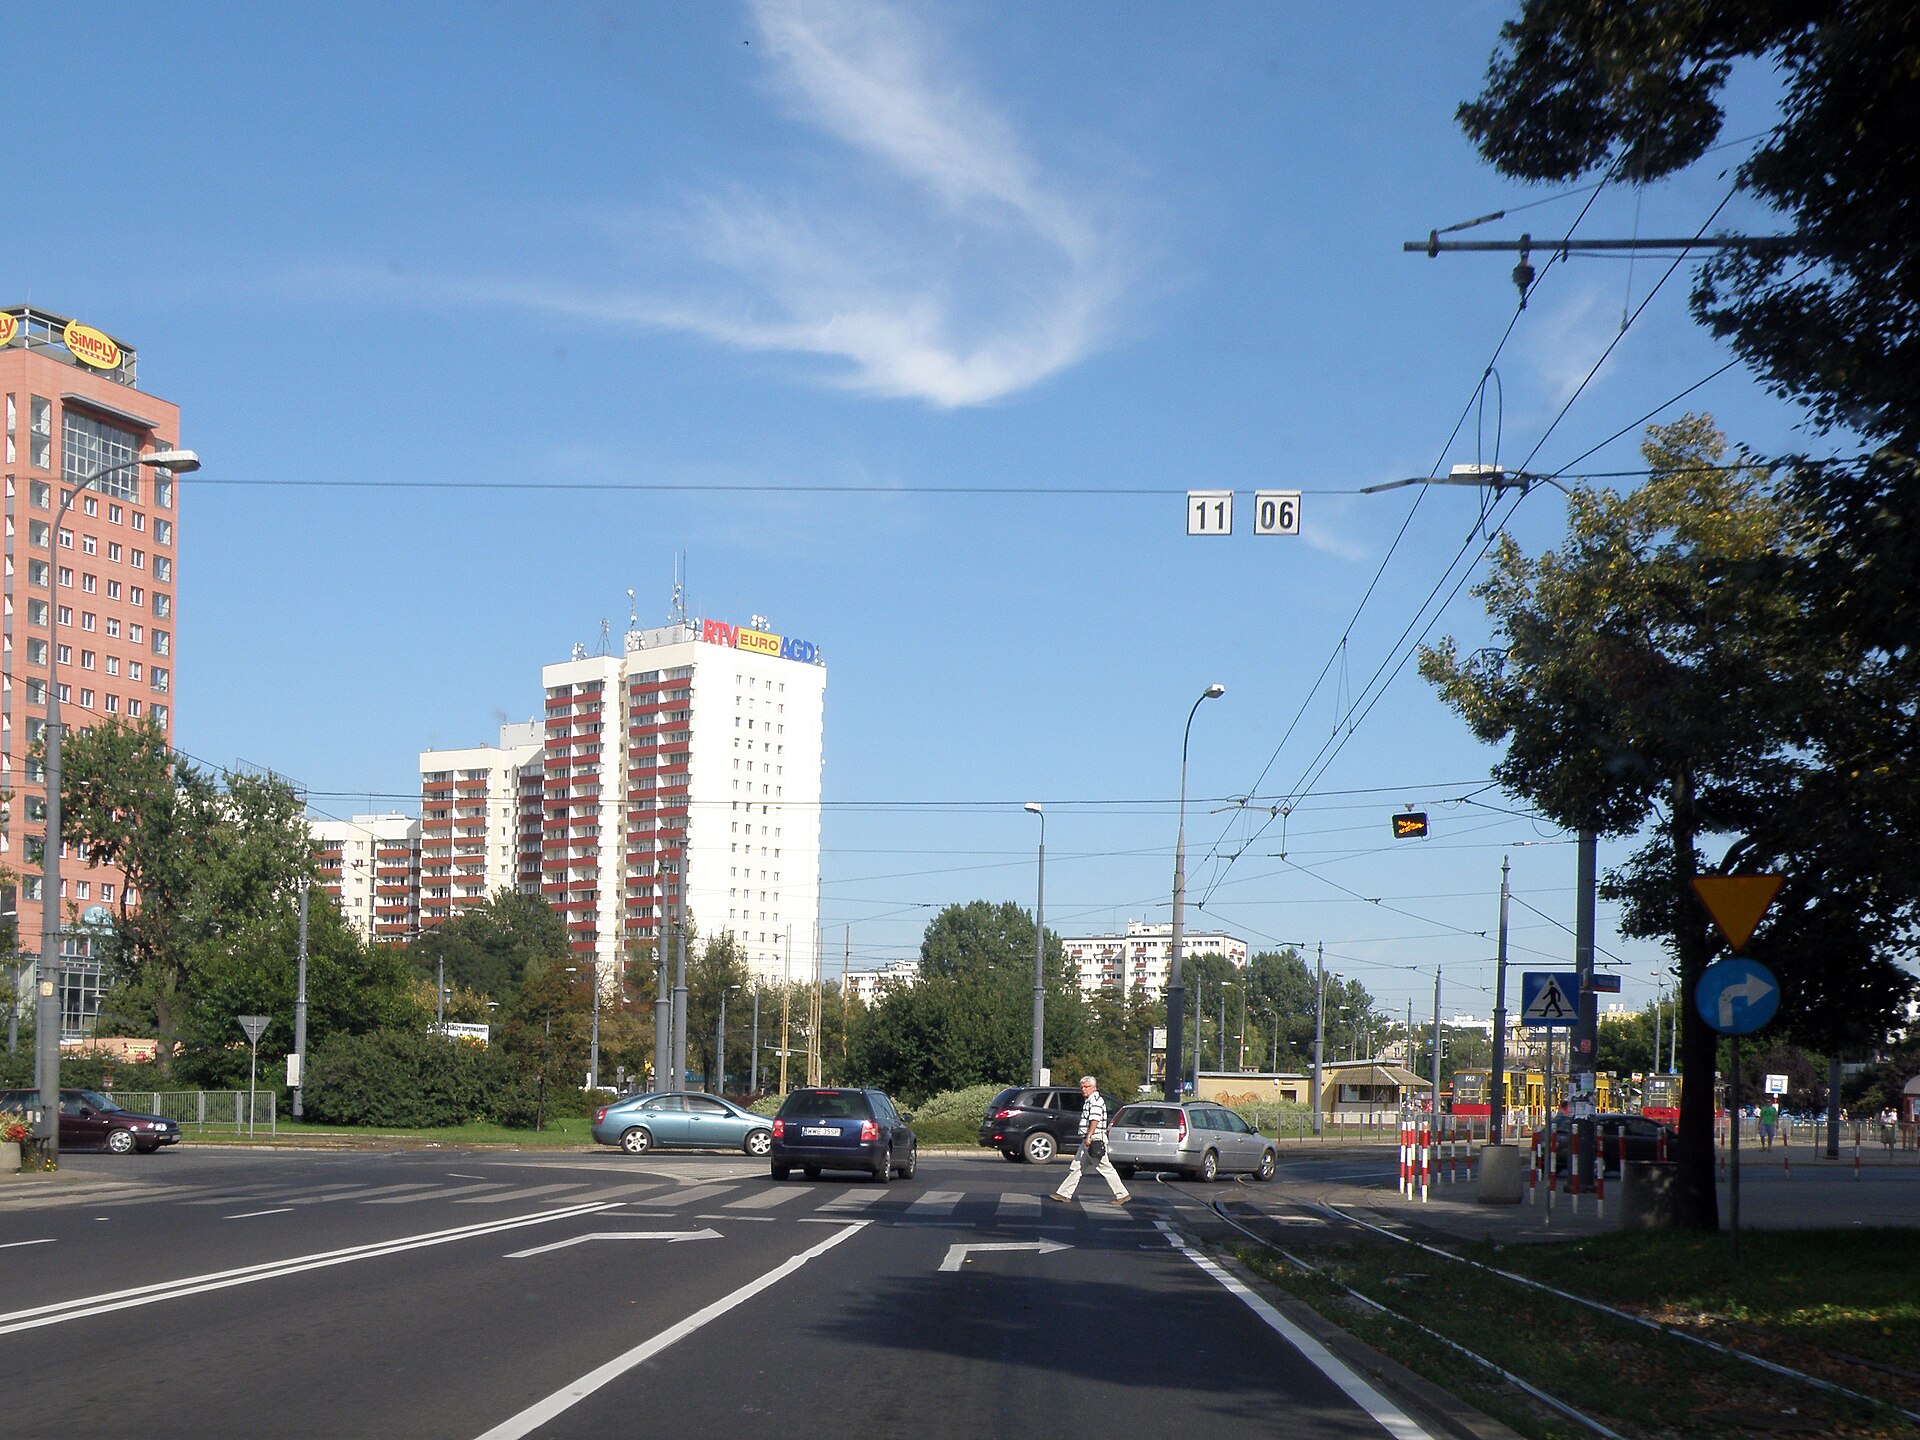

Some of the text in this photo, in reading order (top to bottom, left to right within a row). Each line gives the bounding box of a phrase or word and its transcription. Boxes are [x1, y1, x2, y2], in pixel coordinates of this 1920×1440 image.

[1196, 501, 1294, 530] 11 06
[703, 618, 815, 663] RTV EURO AGD
